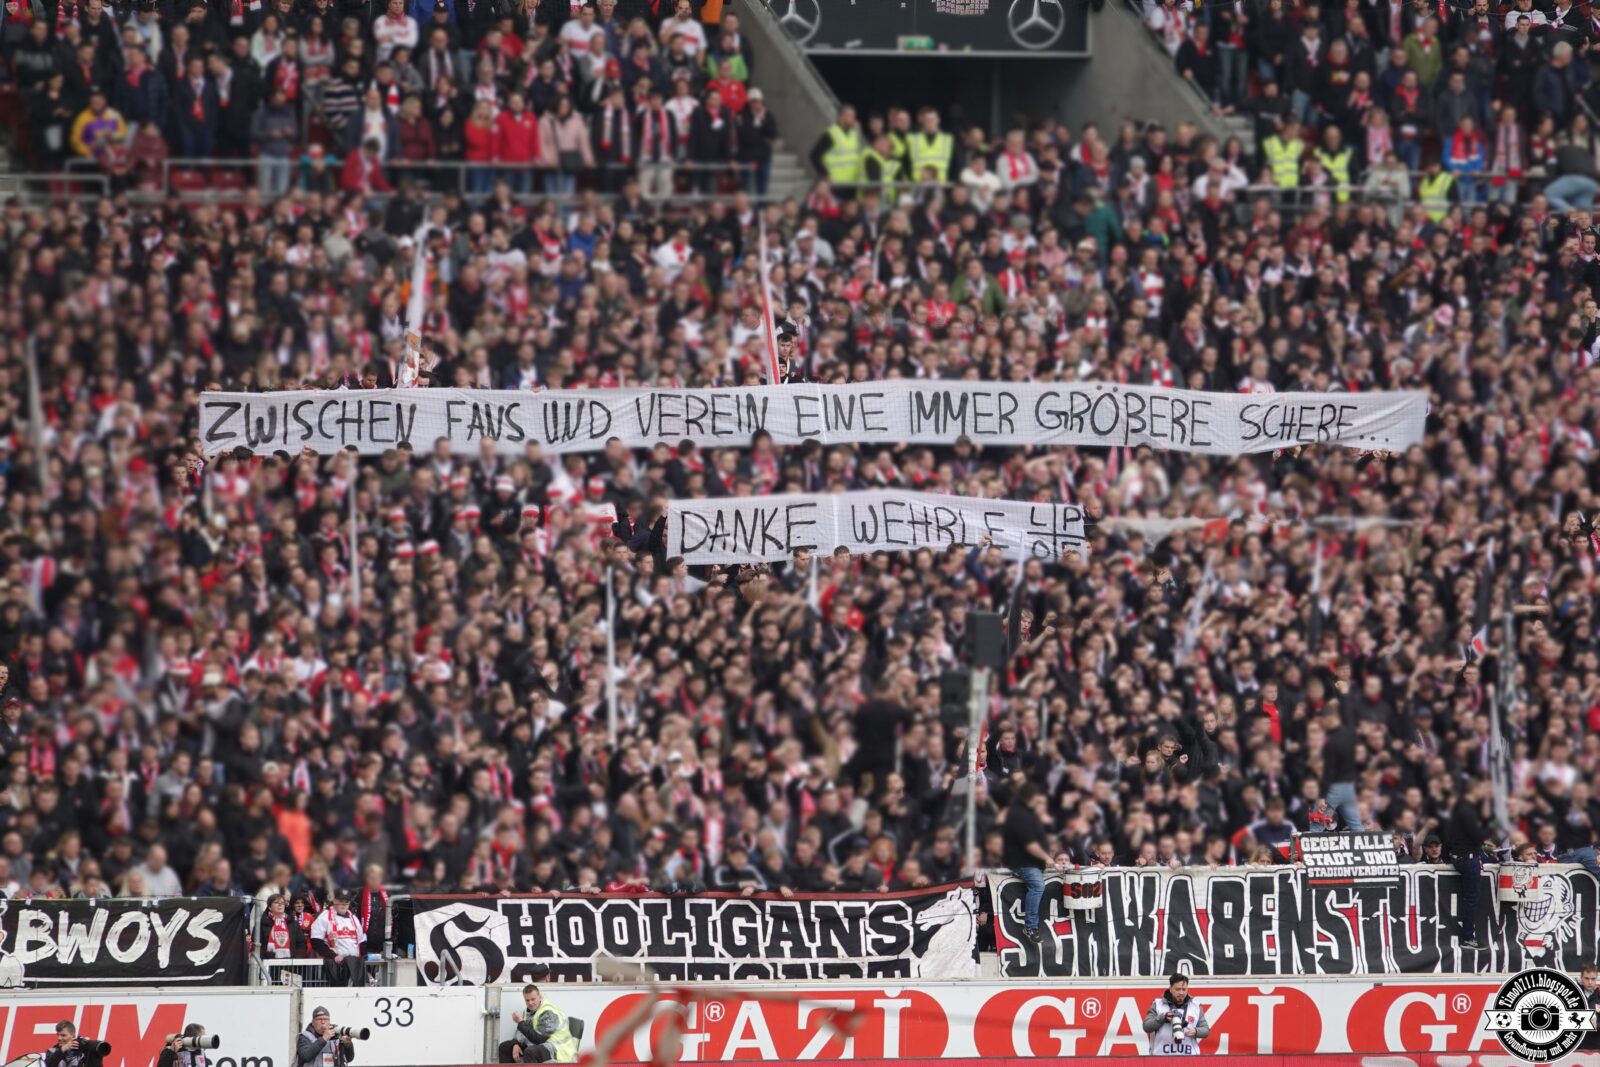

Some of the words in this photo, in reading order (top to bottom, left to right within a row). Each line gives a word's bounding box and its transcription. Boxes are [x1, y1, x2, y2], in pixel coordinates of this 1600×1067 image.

[205, 400, 416, 447] ZWISCHEN
[446, 400, 525, 441] FANS
[543, 399, 612, 444] UND
[636, 393, 768, 437] VEREIN
[793, 392, 888, 437] EINE
[909, 390, 1018, 434] IMMER
[681, 502, 818, 555] DANKE
[851, 501, 1009, 549] WEHRLE
[1301, 836, 1350, 852] GEGEN
[1353, 833, 1394, 850] ALLE
[1303, 851, 1362, 866] STADT-
[1363, 850, 1397, 865] UND
[14, 907, 224, 969] BWOYS
[498, 899, 914, 959] HOOLIGANS
[0, 1003, 187, 1067] EIM
[373, 998, 414, 1027] 33
[1162, 1043, 1192, 1054] CLUB
